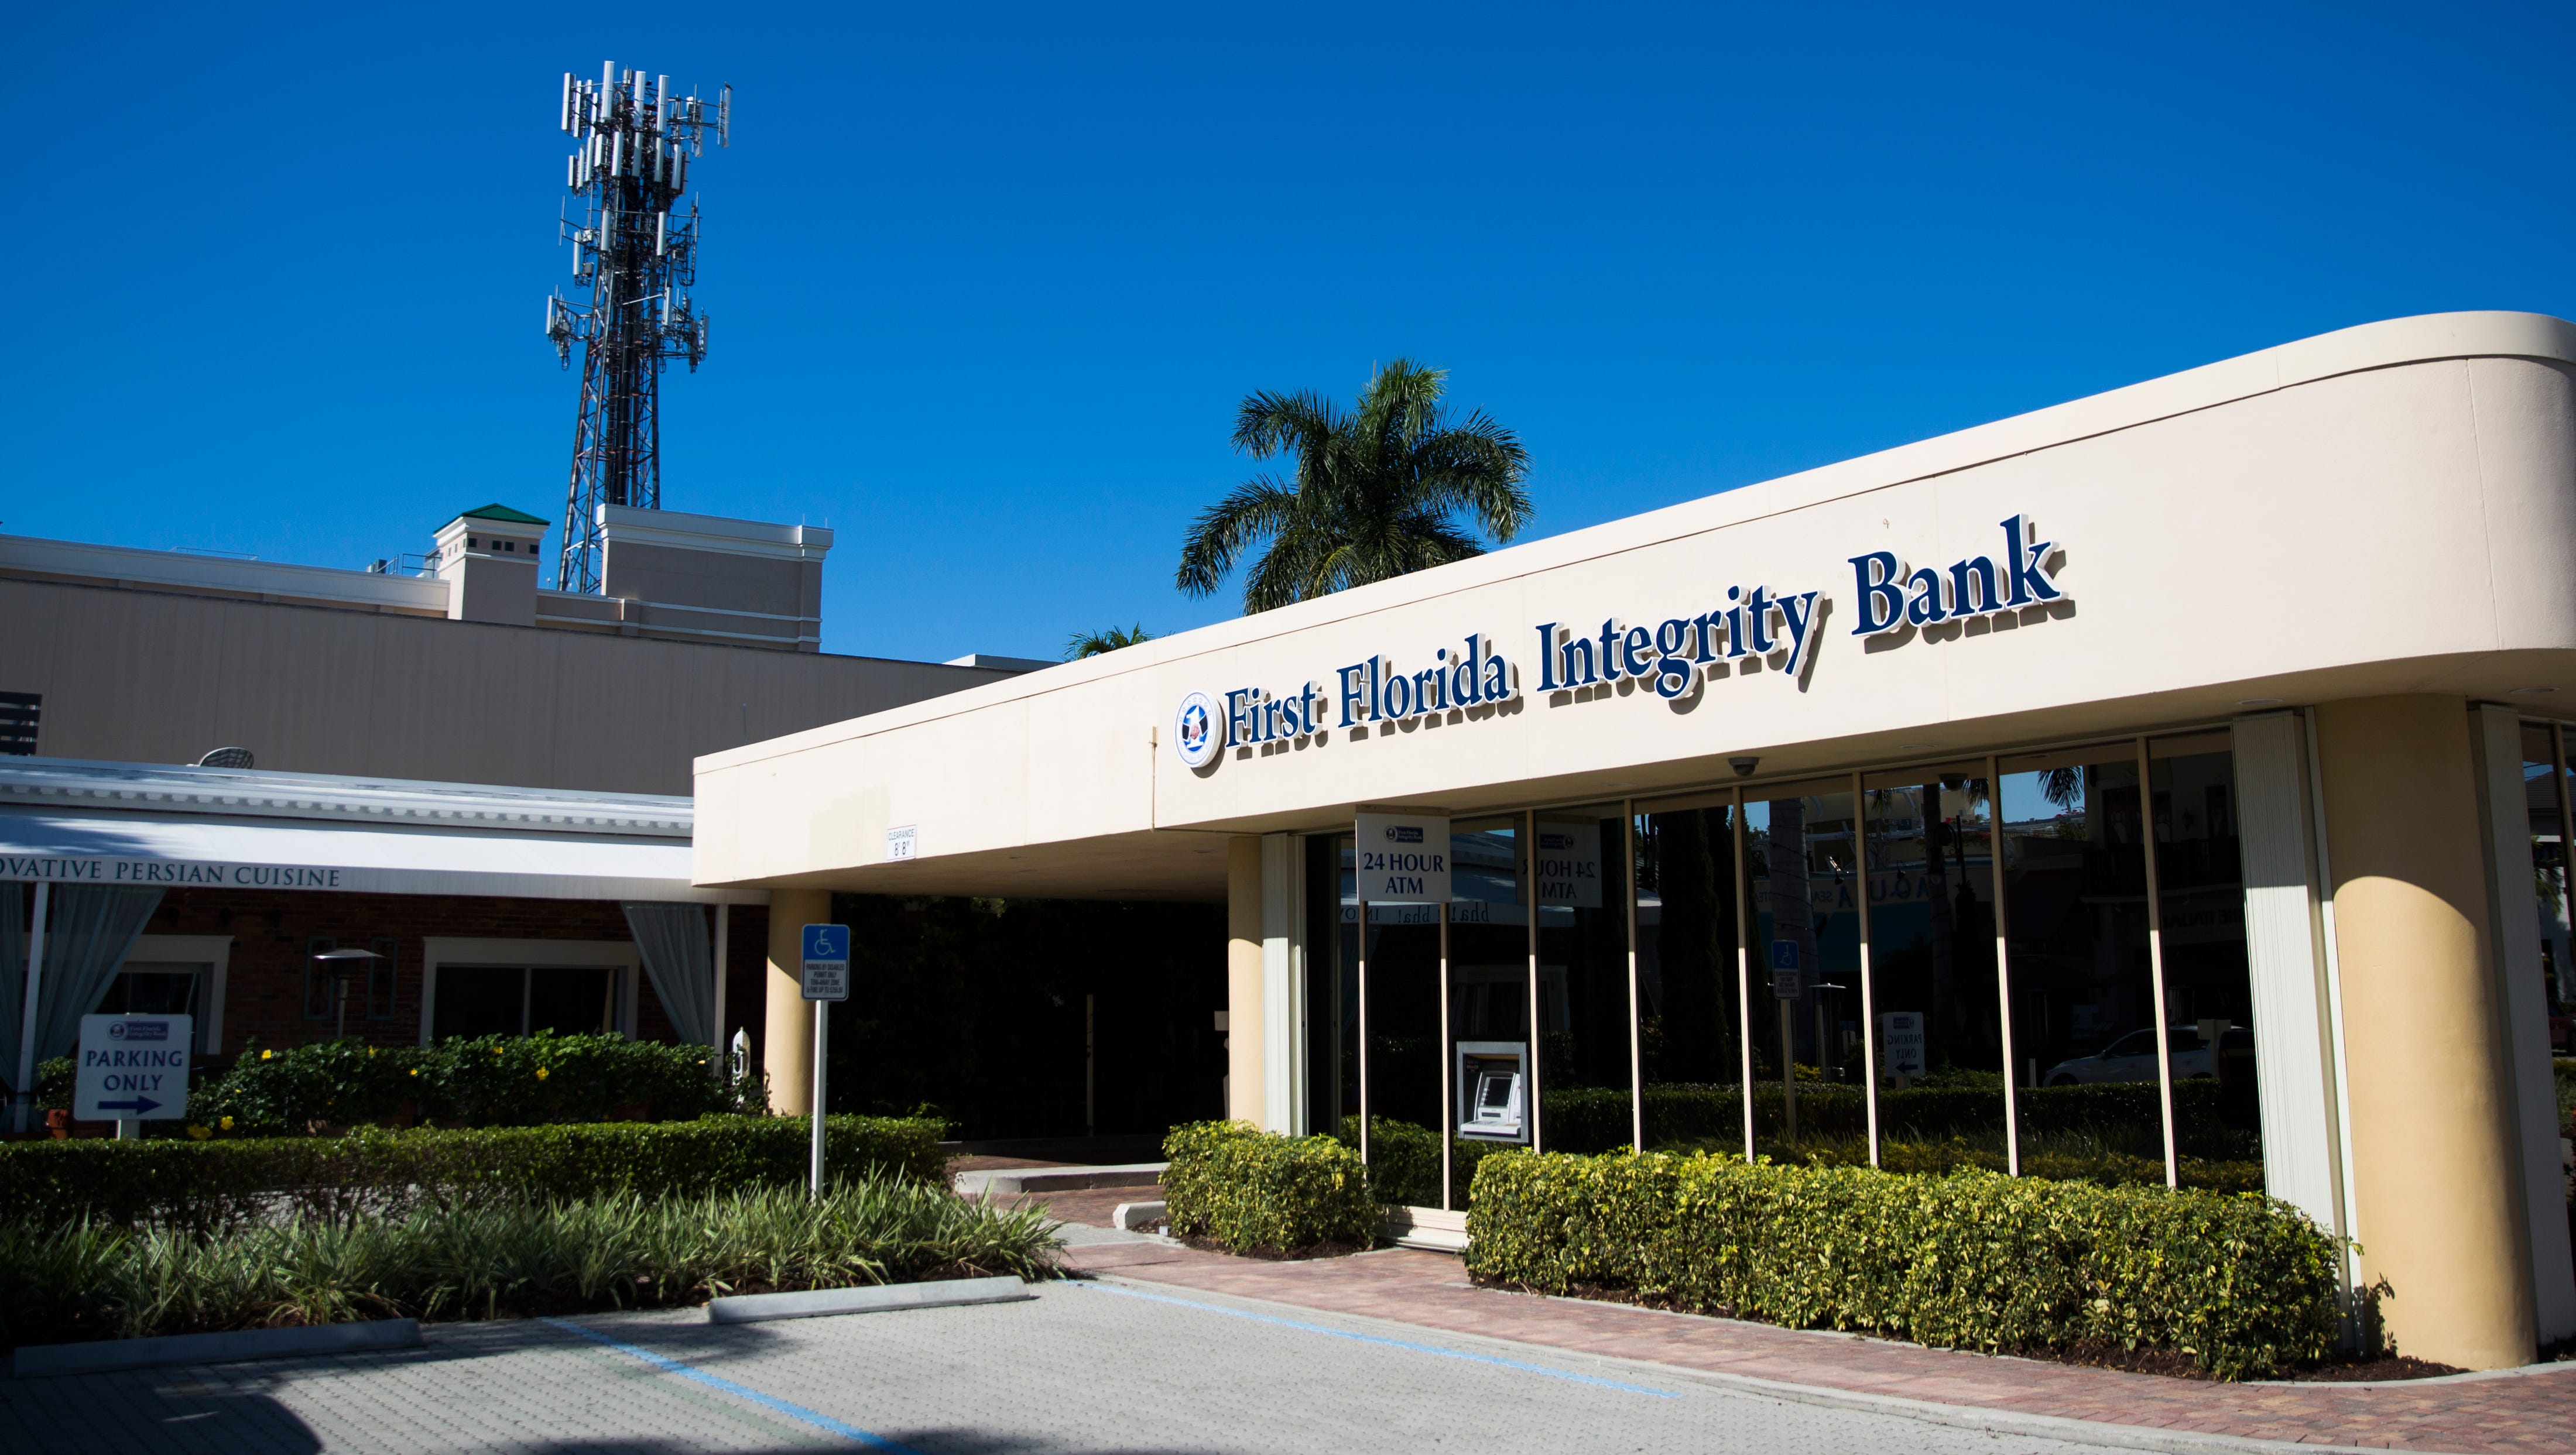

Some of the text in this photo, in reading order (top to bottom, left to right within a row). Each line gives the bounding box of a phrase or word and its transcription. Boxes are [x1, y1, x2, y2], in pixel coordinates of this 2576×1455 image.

[1225, 514, 2061, 748] First Florida Integrity Bank
[889, 828, 914, 841] CLEARANCE
[1364, 852, 1444, 871] 24 HOUR
[117, 862, 225, 883] PERSIAN
[235, 866, 340, 887] CUISINE
[1385, 877, 1423, 894] ATM
[86, 1050, 183, 1066] PARKING
[104, 1075, 163, 1091] ONLY
